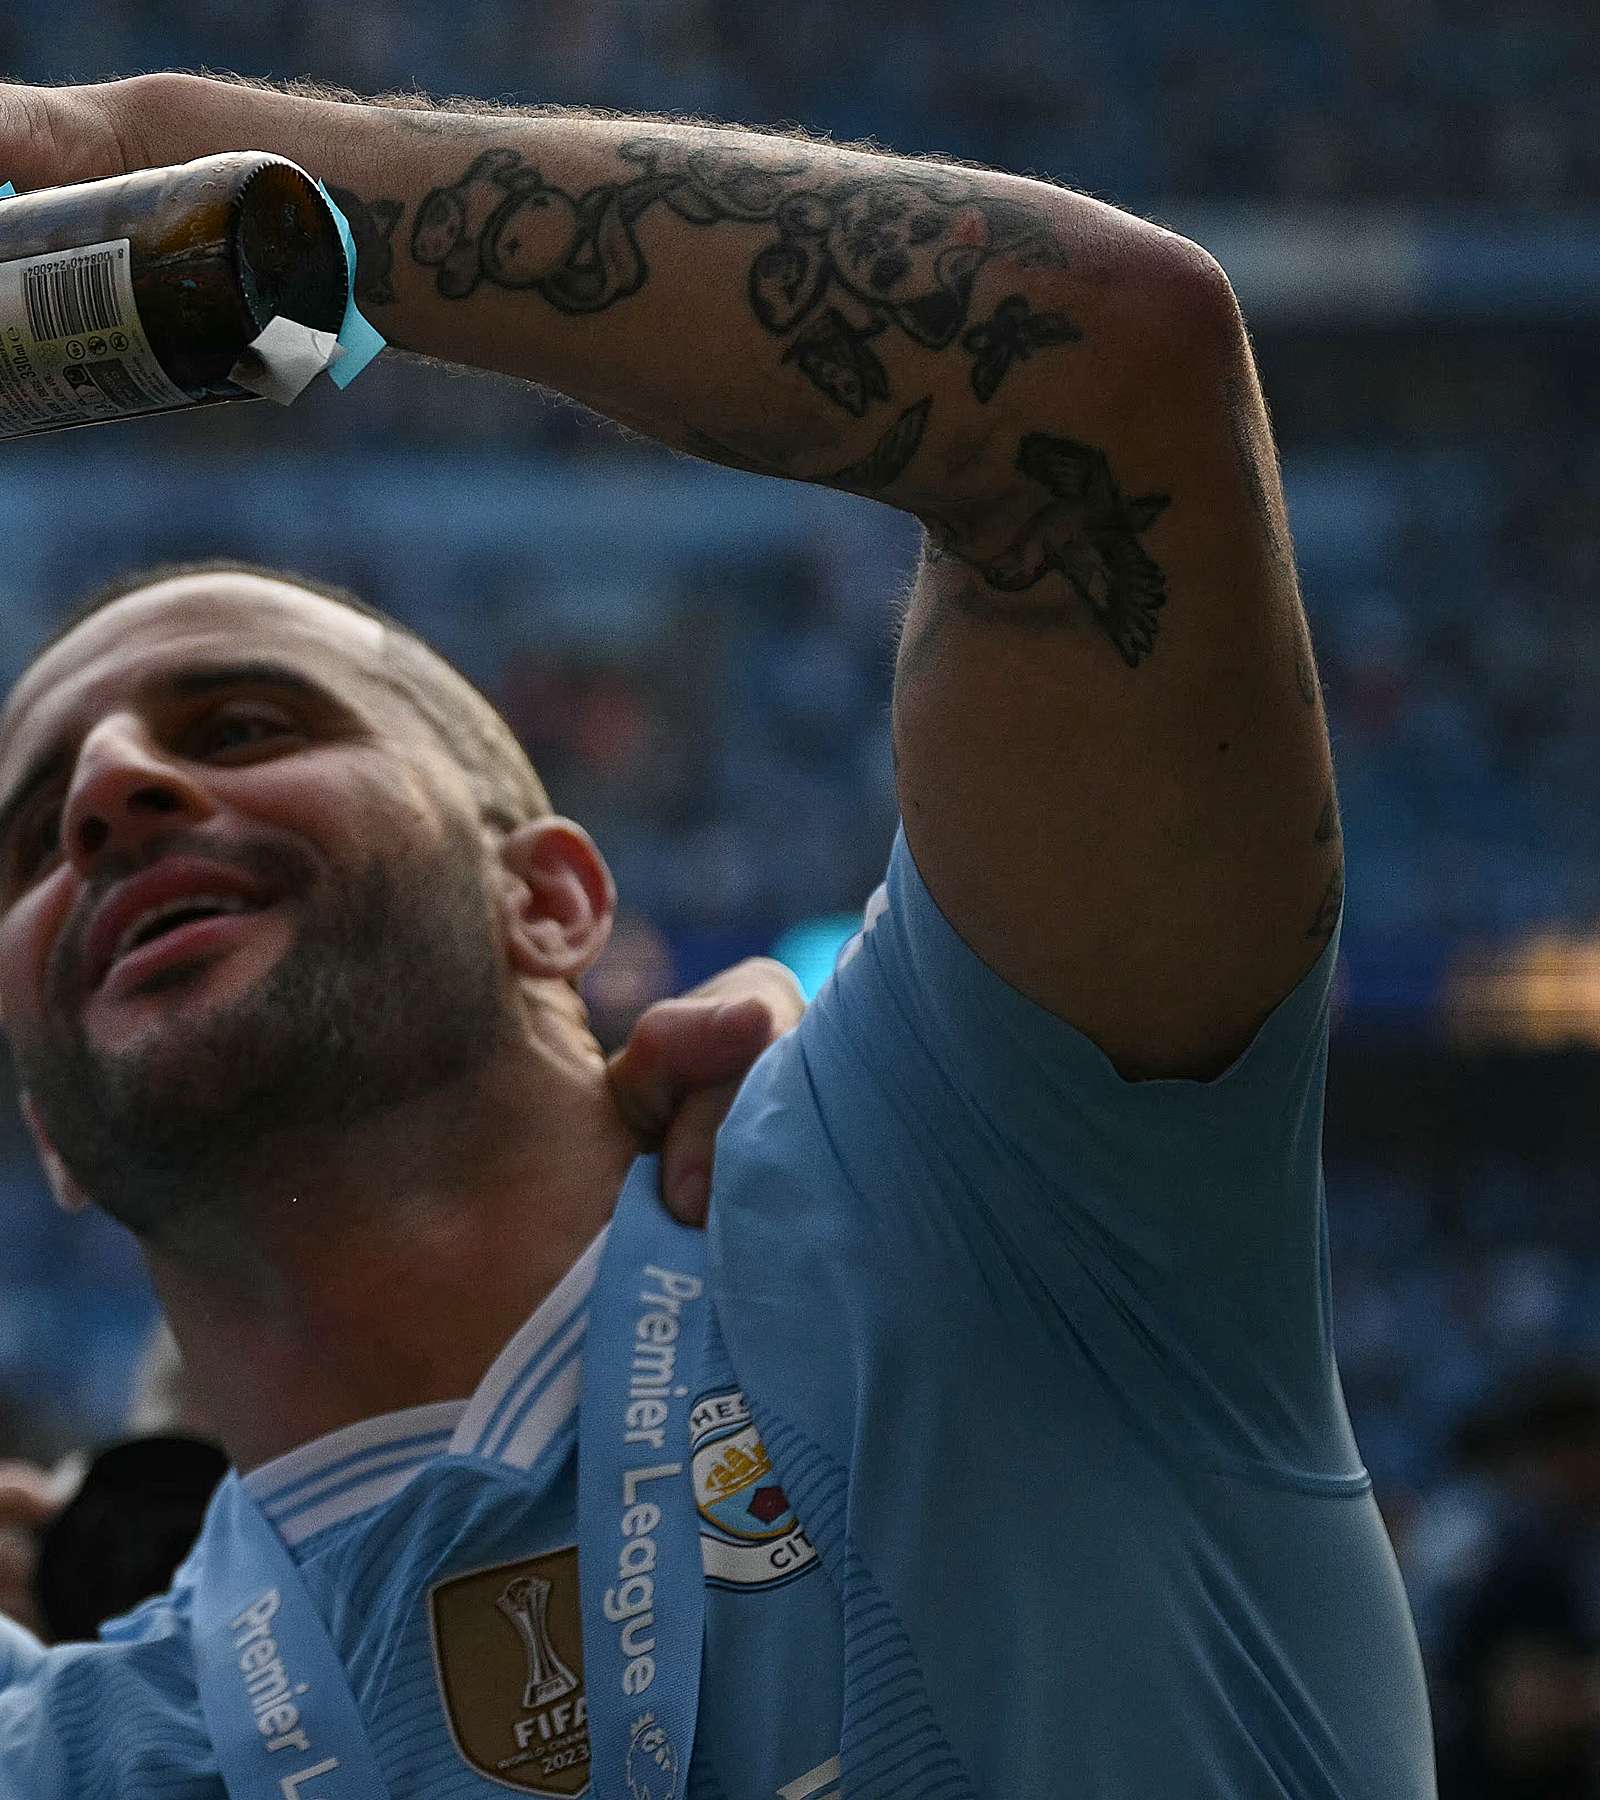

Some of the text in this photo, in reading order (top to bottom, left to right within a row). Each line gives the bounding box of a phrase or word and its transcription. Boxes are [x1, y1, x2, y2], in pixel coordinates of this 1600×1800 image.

[12, 344, 36, 379] 330ml
[603, 1264, 703, 1696] Premier League
[769, 1529, 816, 1569] CIT
[229, 1589, 311, 1752] Premier
[542, 1744, 590, 1776] 2023
